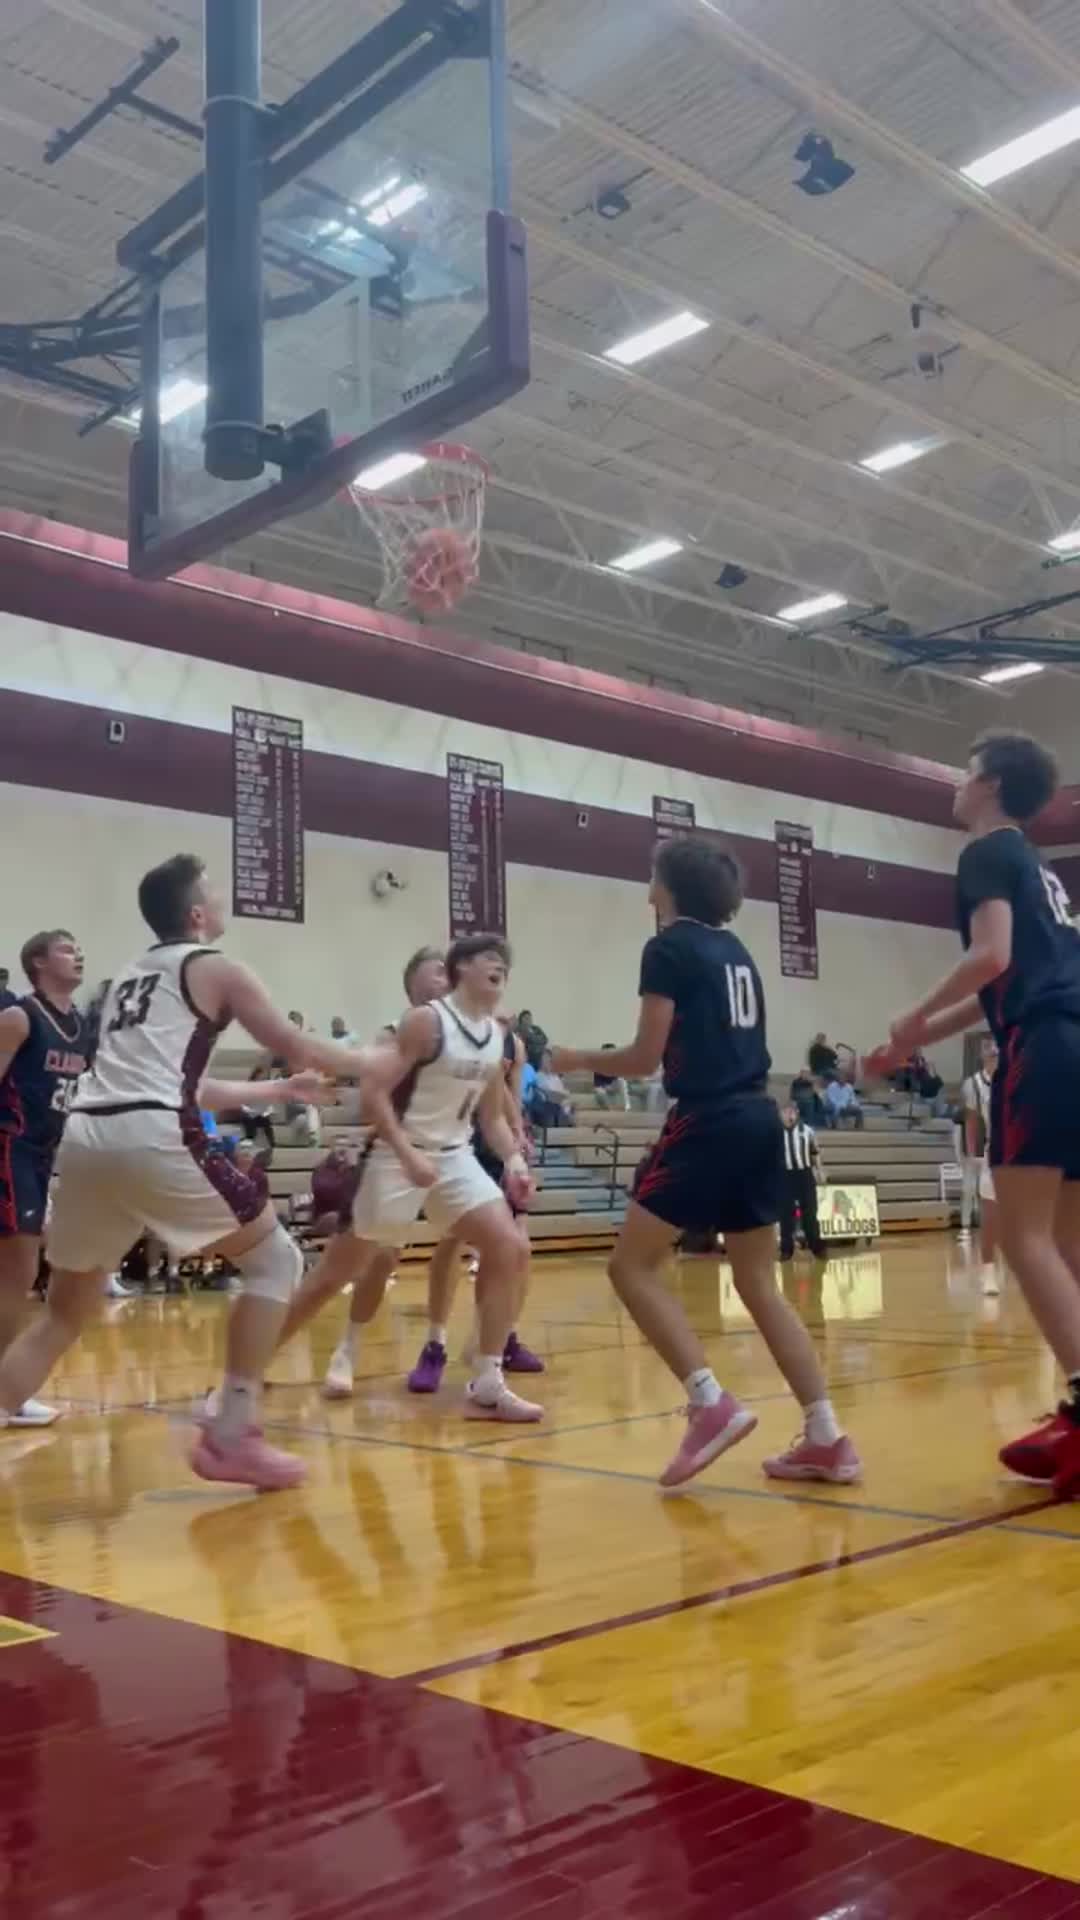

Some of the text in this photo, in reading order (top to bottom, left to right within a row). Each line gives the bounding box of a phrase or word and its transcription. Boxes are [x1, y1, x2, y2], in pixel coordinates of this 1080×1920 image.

[107, 974, 161, 1031] 33
[724, 963, 757, 1028] 10
[819, 1218, 878, 1235] ULLDOGS
